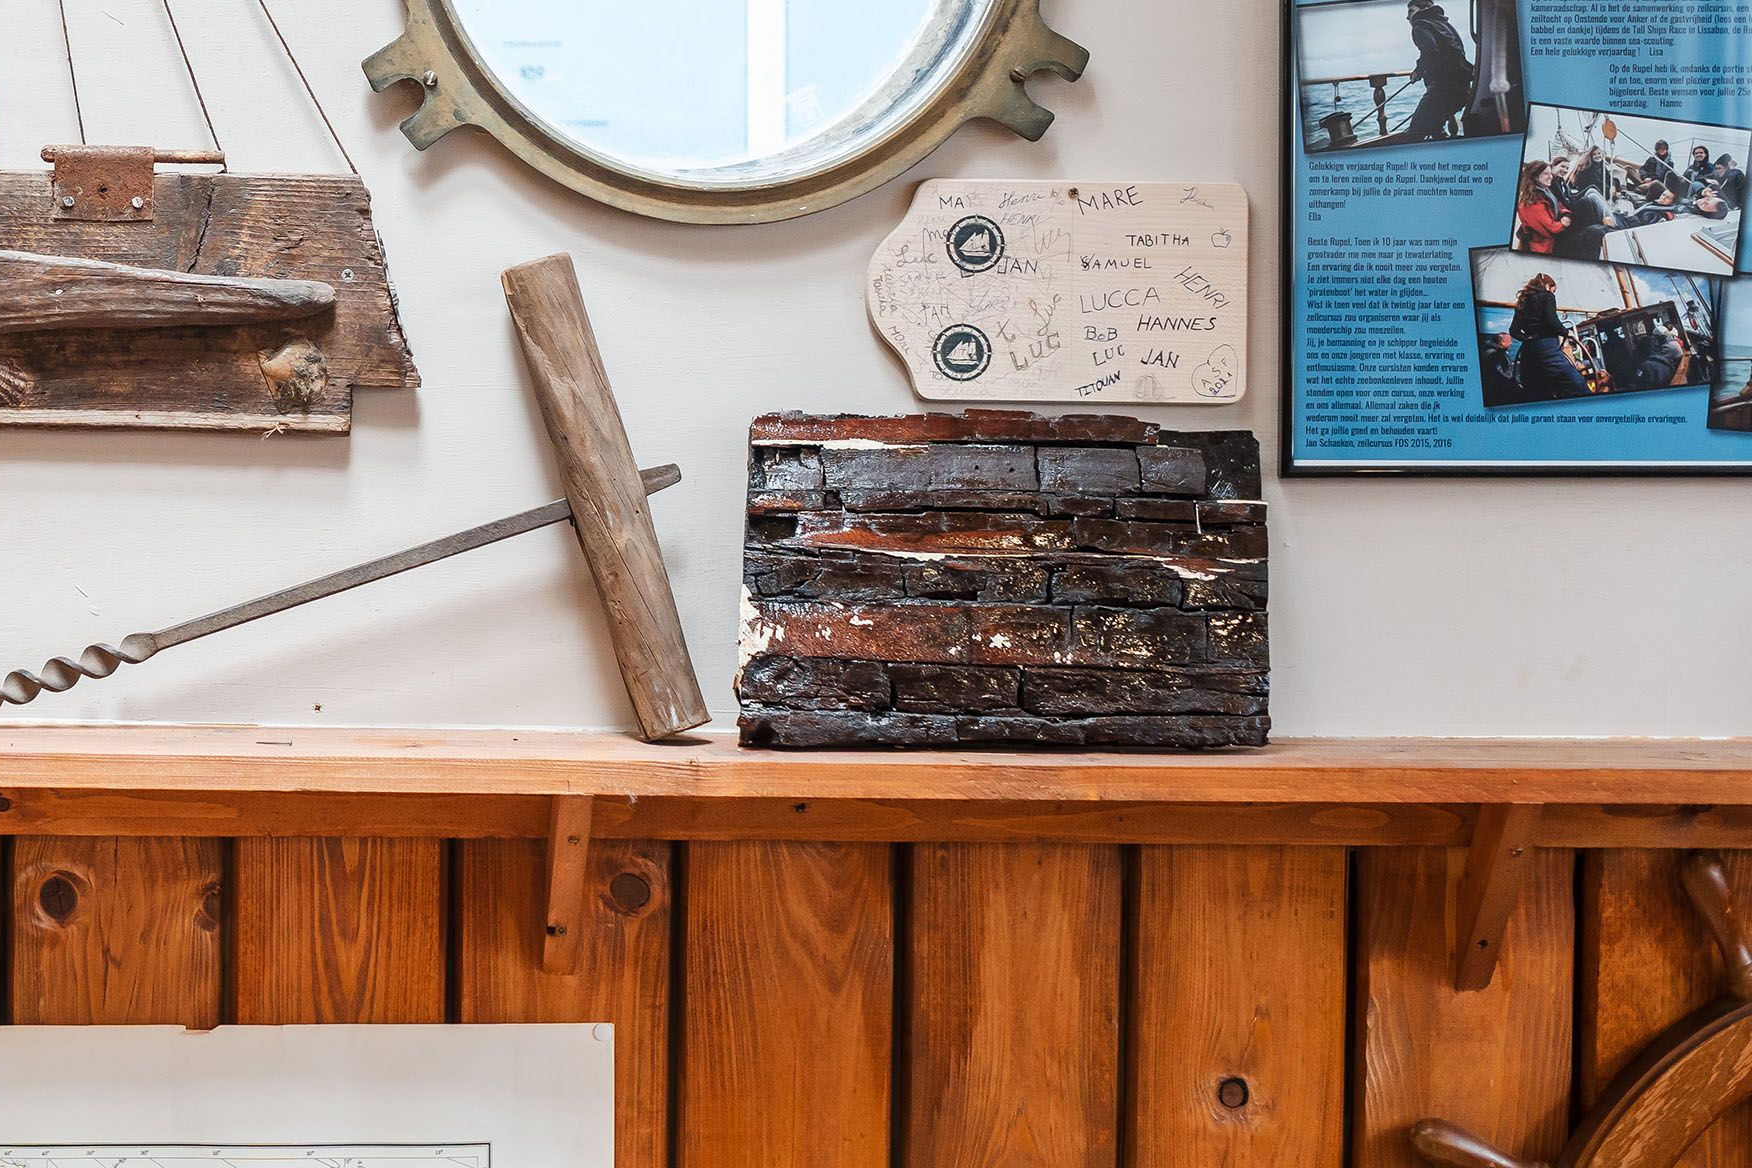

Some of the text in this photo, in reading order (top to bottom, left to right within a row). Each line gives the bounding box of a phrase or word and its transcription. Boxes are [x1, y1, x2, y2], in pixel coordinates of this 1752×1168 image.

[1077, 185, 1144, 215] MARE
[1308, 213, 1322, 221] Ella
[1125, 233, 1190, 247] TABITHA
[998, 256, 1038, 275] JAN
[1080, 252, 1152, 271] SAMUEL
[1173, 266, 1231, 310] HENRI
[1080, 287, 1161, 314] LUCCA
[1137, 314, 1217, 331] HANNES
[1093, 344, 1125, 367] LUC
[1140, 347, 1180, 368] JAN
[1075, 370, 1121, 398] TITOUAN
[1306, 439, 1318, 448] Jan
